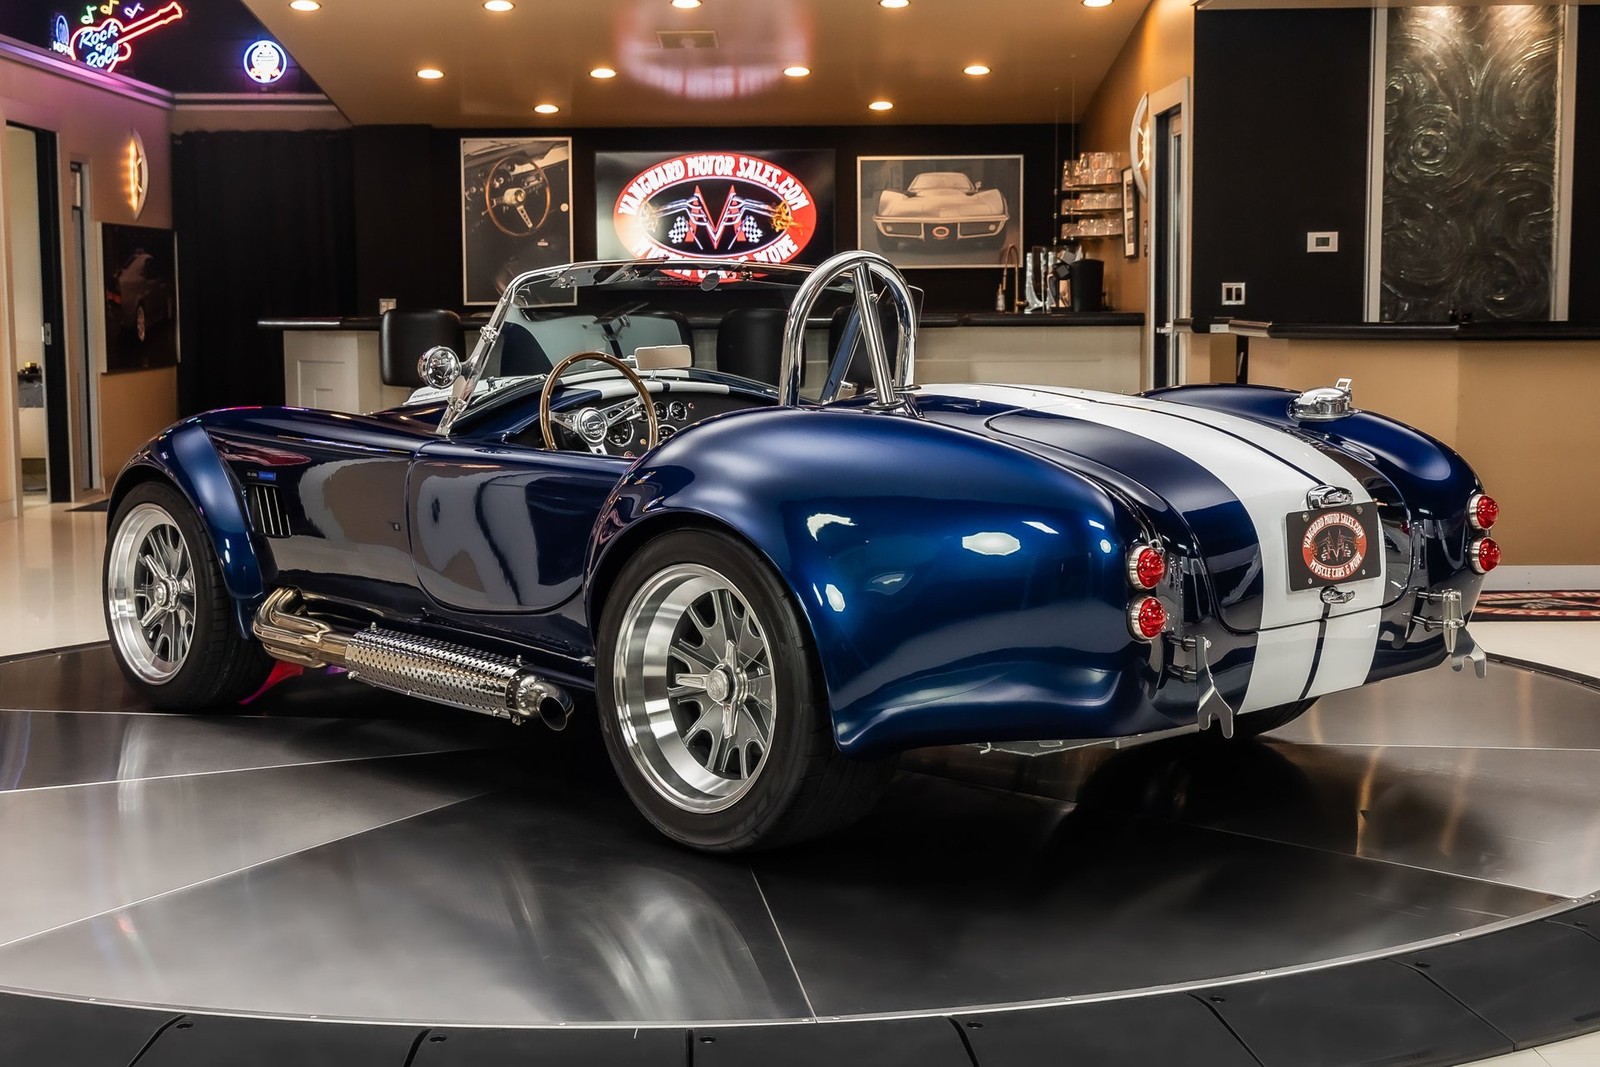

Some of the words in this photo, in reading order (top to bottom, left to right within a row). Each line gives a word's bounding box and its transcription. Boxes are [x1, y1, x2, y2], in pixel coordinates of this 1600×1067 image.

[79, 21, 119, 49] Rock
[86, 42, 119, 68] Roll
[618, 159, 685, 217] VANGUARD
[686, 154, 736, 177] MOTOR
[736, 156, 810, 211] SALES.COM
[1304, 517, 1325, 548] VANGUARD
[1324, 513, 1340, 526] MOTOR
[1340, 513, 1364, 538] SALES.COM
[1309, 559, 1331, 578] MUSCLE
[1331, 566, 1345, 578] CARS
